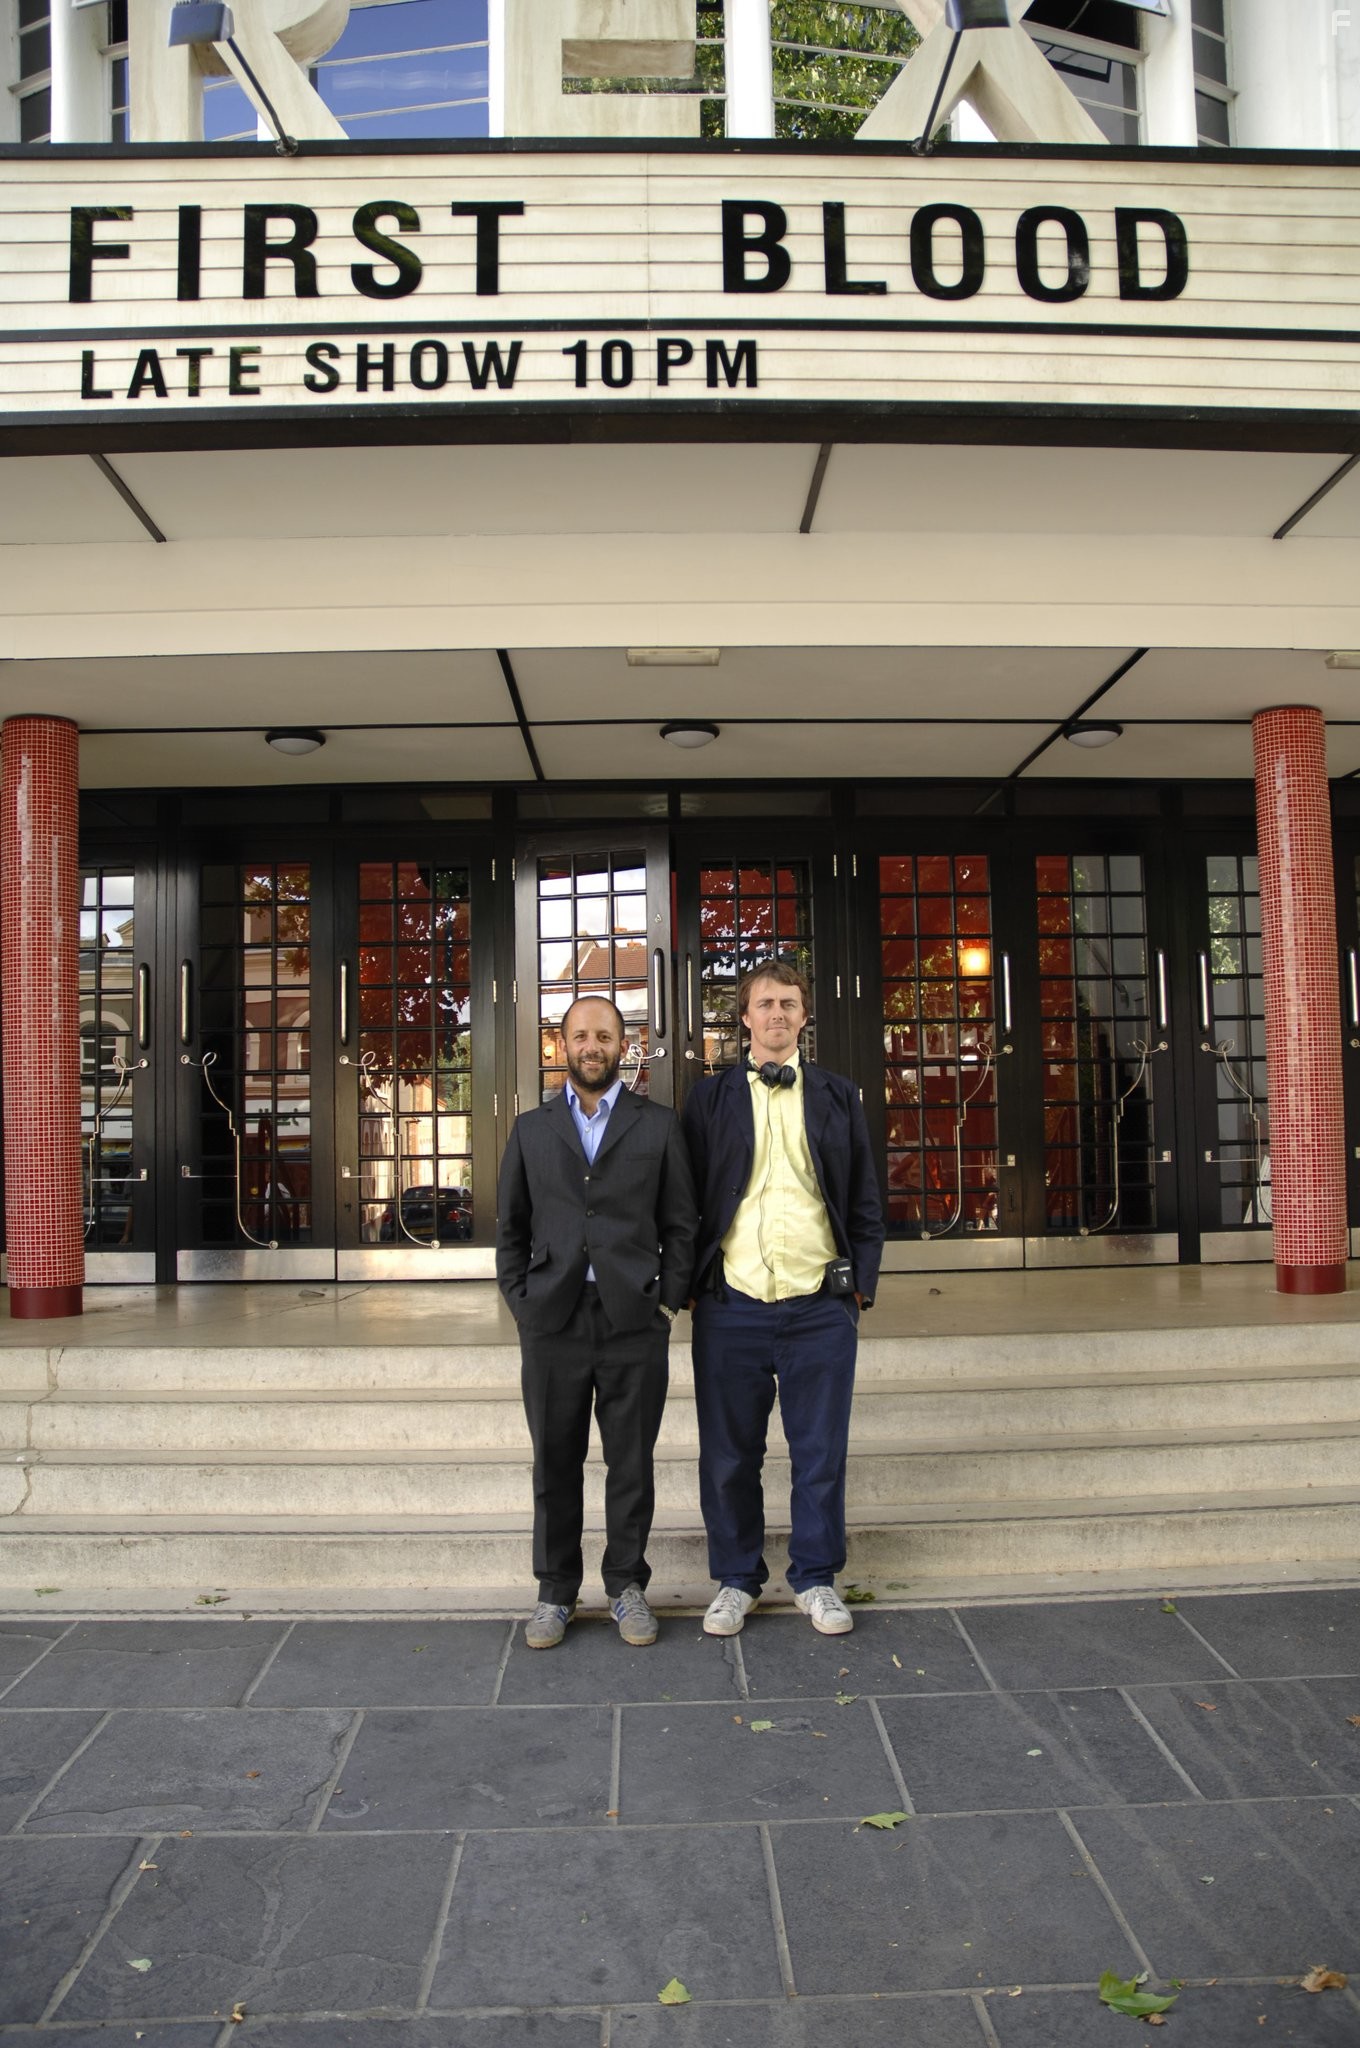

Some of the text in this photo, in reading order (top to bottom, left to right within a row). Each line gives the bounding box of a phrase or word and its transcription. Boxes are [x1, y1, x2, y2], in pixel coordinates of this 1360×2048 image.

[68, 199, 1189, 304] FIRST BLOOD
[80, 345, 264, 400] LATE
[303, 340, 523, 394] SHOW
